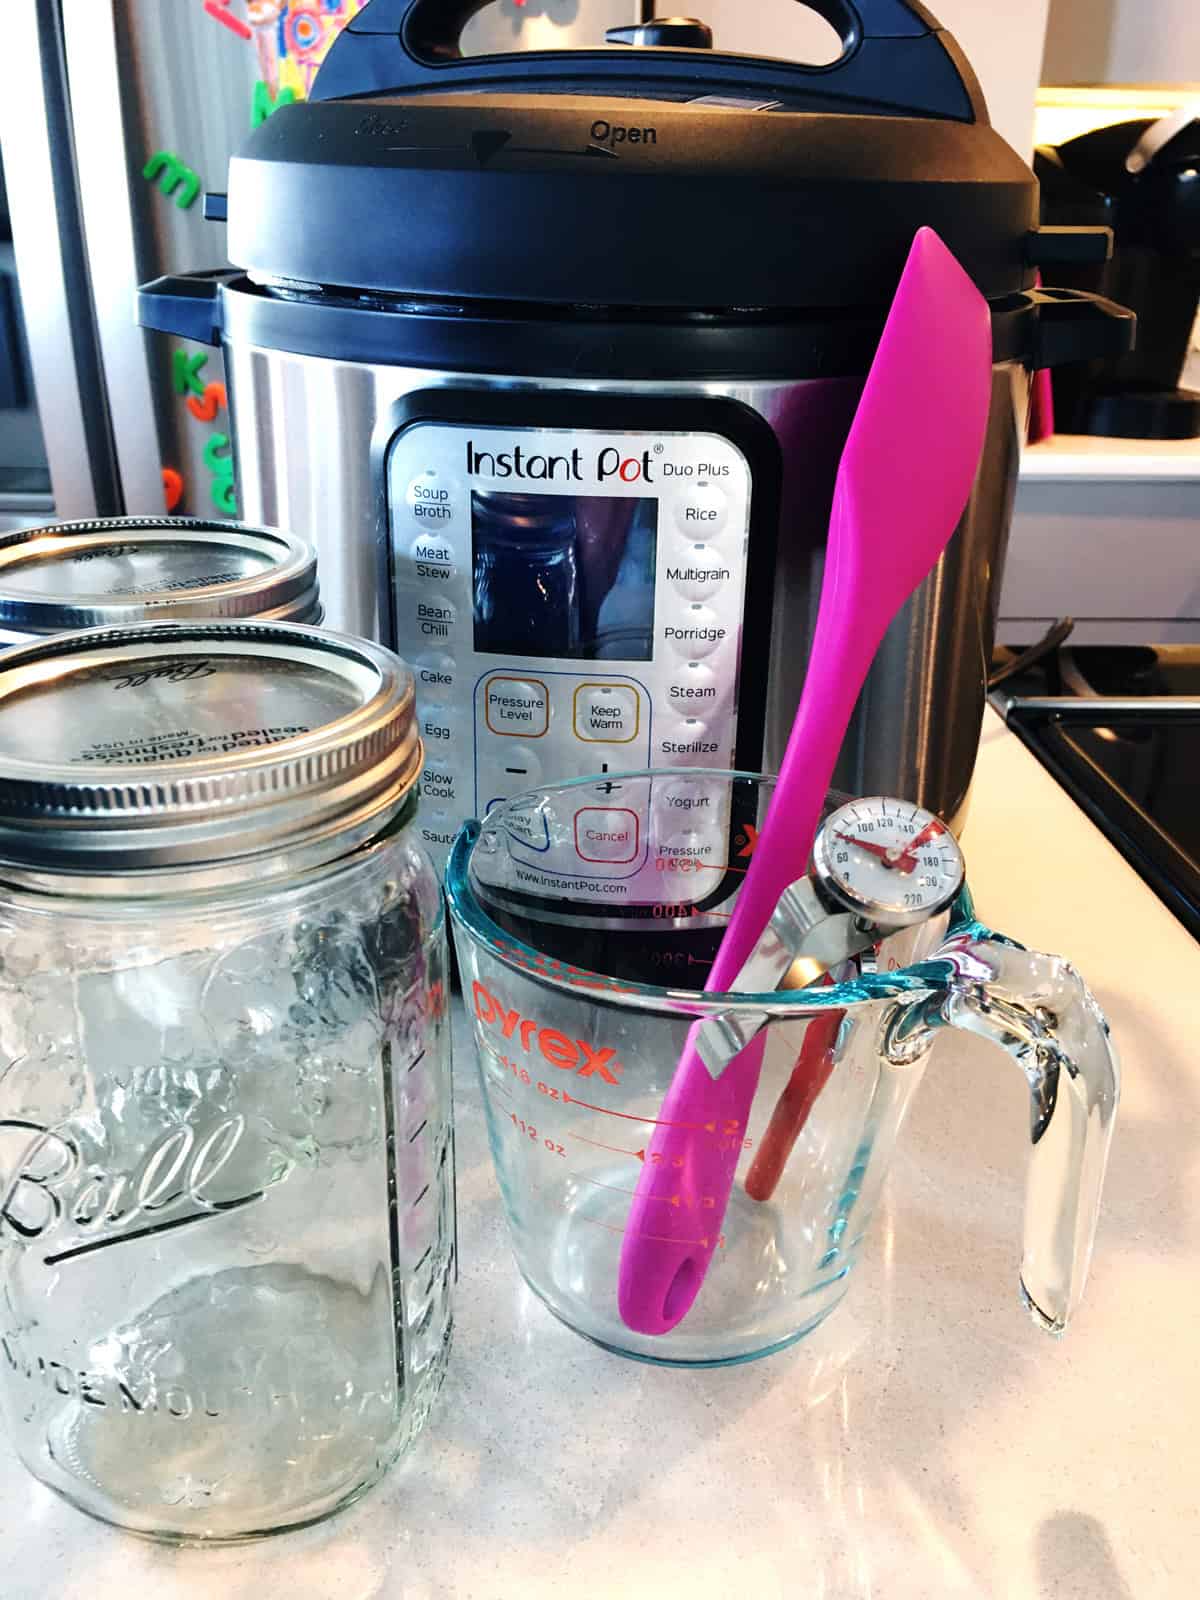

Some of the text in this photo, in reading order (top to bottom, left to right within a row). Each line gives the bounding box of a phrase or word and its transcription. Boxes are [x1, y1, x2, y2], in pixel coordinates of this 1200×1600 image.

[590, 120, 657, 146] Open
[467, 441, 583, 481] Instant
[663, 463, 730, 477] Duo Plus
[413, 485, 449, 502] Soup
[414, 504, 452, 520] Broth
[685, 507, 718, 522] Rice
[415, 546, 450, 561] Meat
[416, 565, 451, 580] Stew
[665, 567, 730, 584] Multigrain
[417, 604, 451, 620] Bean
[420, 622, 449, 638] Chili
[664, 625, 727, 642] Porridge
[420, 670, 453, 685] Cake
[669, 685, 716, 699] Steam
[488, 695, 545, 711] Pressure
[499, 708, 533, 722] Level
[590, 706, 622, 721] Keep
[424, 723, 451, 740] Egg
[590, 718, 624, 731] Warm
[148, 729, 190, 743] Made
[91, 740, 124, 751] USA
[661, 740, 719, 754] Sterilize
[423, 770, 454, 786] Slow
[423, 785, 456, 800] Cook
[664, 795, 711, 811] Yogurt
[856, 822, 875, 833] 100
[877, 818, 894, 829] 120
[585, 829, 630, 844] Cancel
[658, 844, 713, 858] Pressure
[836, 851, 849, 864] 60
[922, 856, 940, 868] 180
[537, 1080, 560, 1101] oz
[544, 1138, 567, 1159] oz
[0, 1112, 268, 1242] Ball
